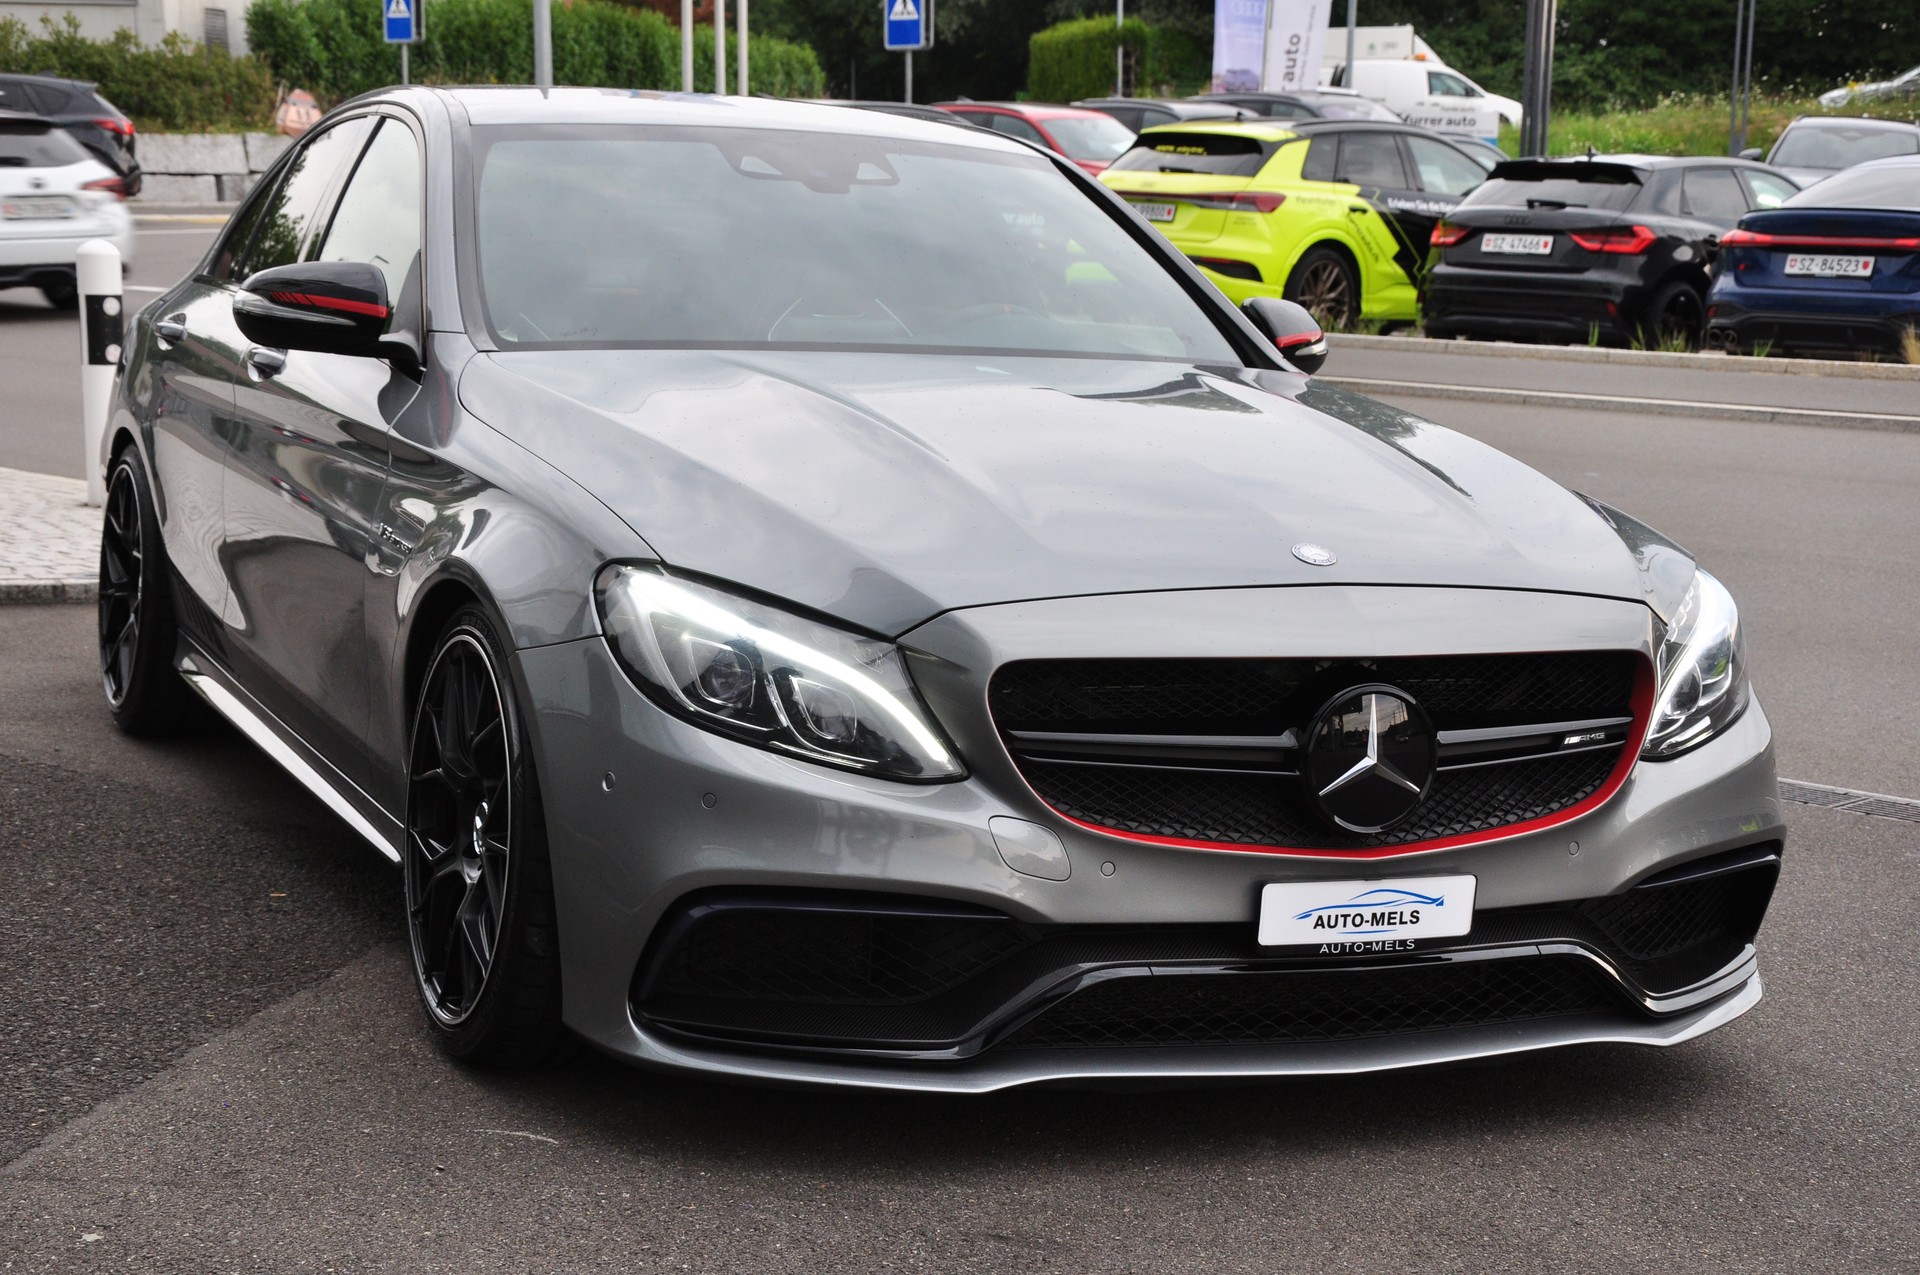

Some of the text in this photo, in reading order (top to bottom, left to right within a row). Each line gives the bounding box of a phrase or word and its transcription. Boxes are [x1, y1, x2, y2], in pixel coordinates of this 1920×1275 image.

[1282, 34, 1301, 82] auto
[1446, 115, 1476, 127] auto
[1313, 909, 1421, 930] AUTO-MELS
[1319, 939, 1416, 954] AUTO-MELS
